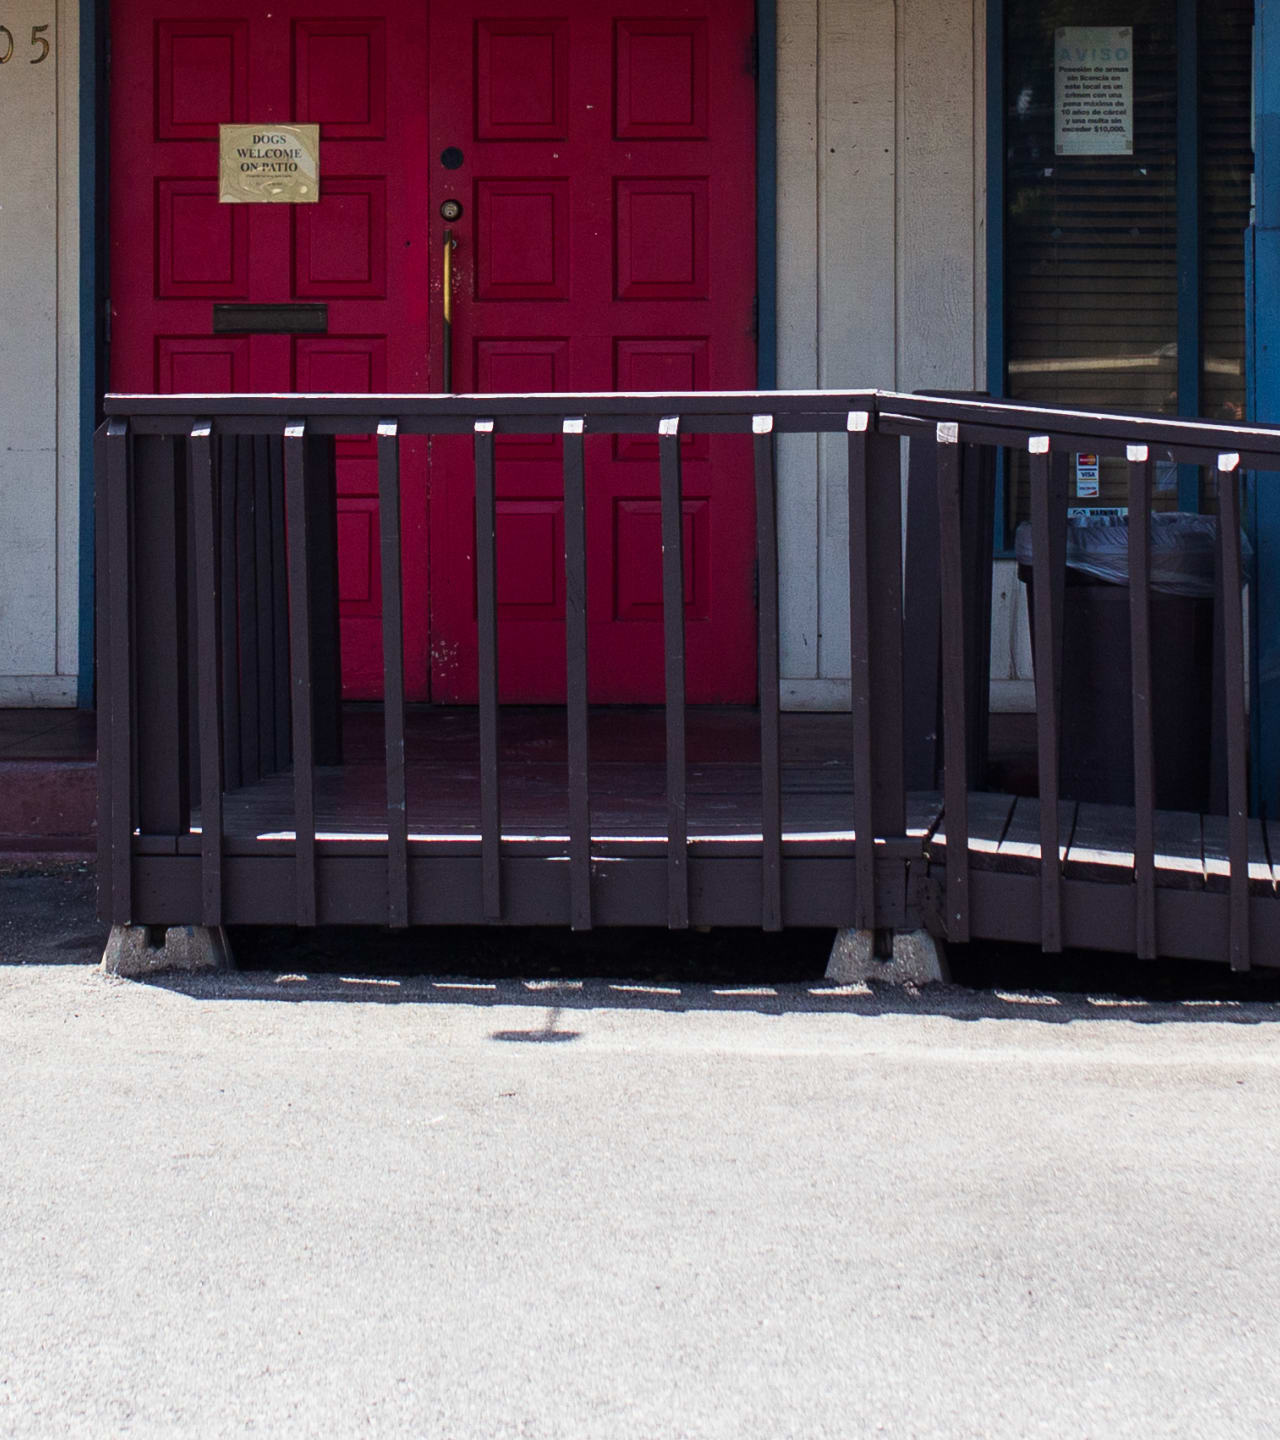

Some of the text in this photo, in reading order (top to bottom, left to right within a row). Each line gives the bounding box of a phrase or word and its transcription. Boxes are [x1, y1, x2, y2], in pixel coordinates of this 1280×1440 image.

[1057, 47, 1129, 61] AVISO
[252, 135, 287, 144] DOGS
[236, 148, 303, 159] WELCOME
[240, 162, 298, 172] ON PATIO
